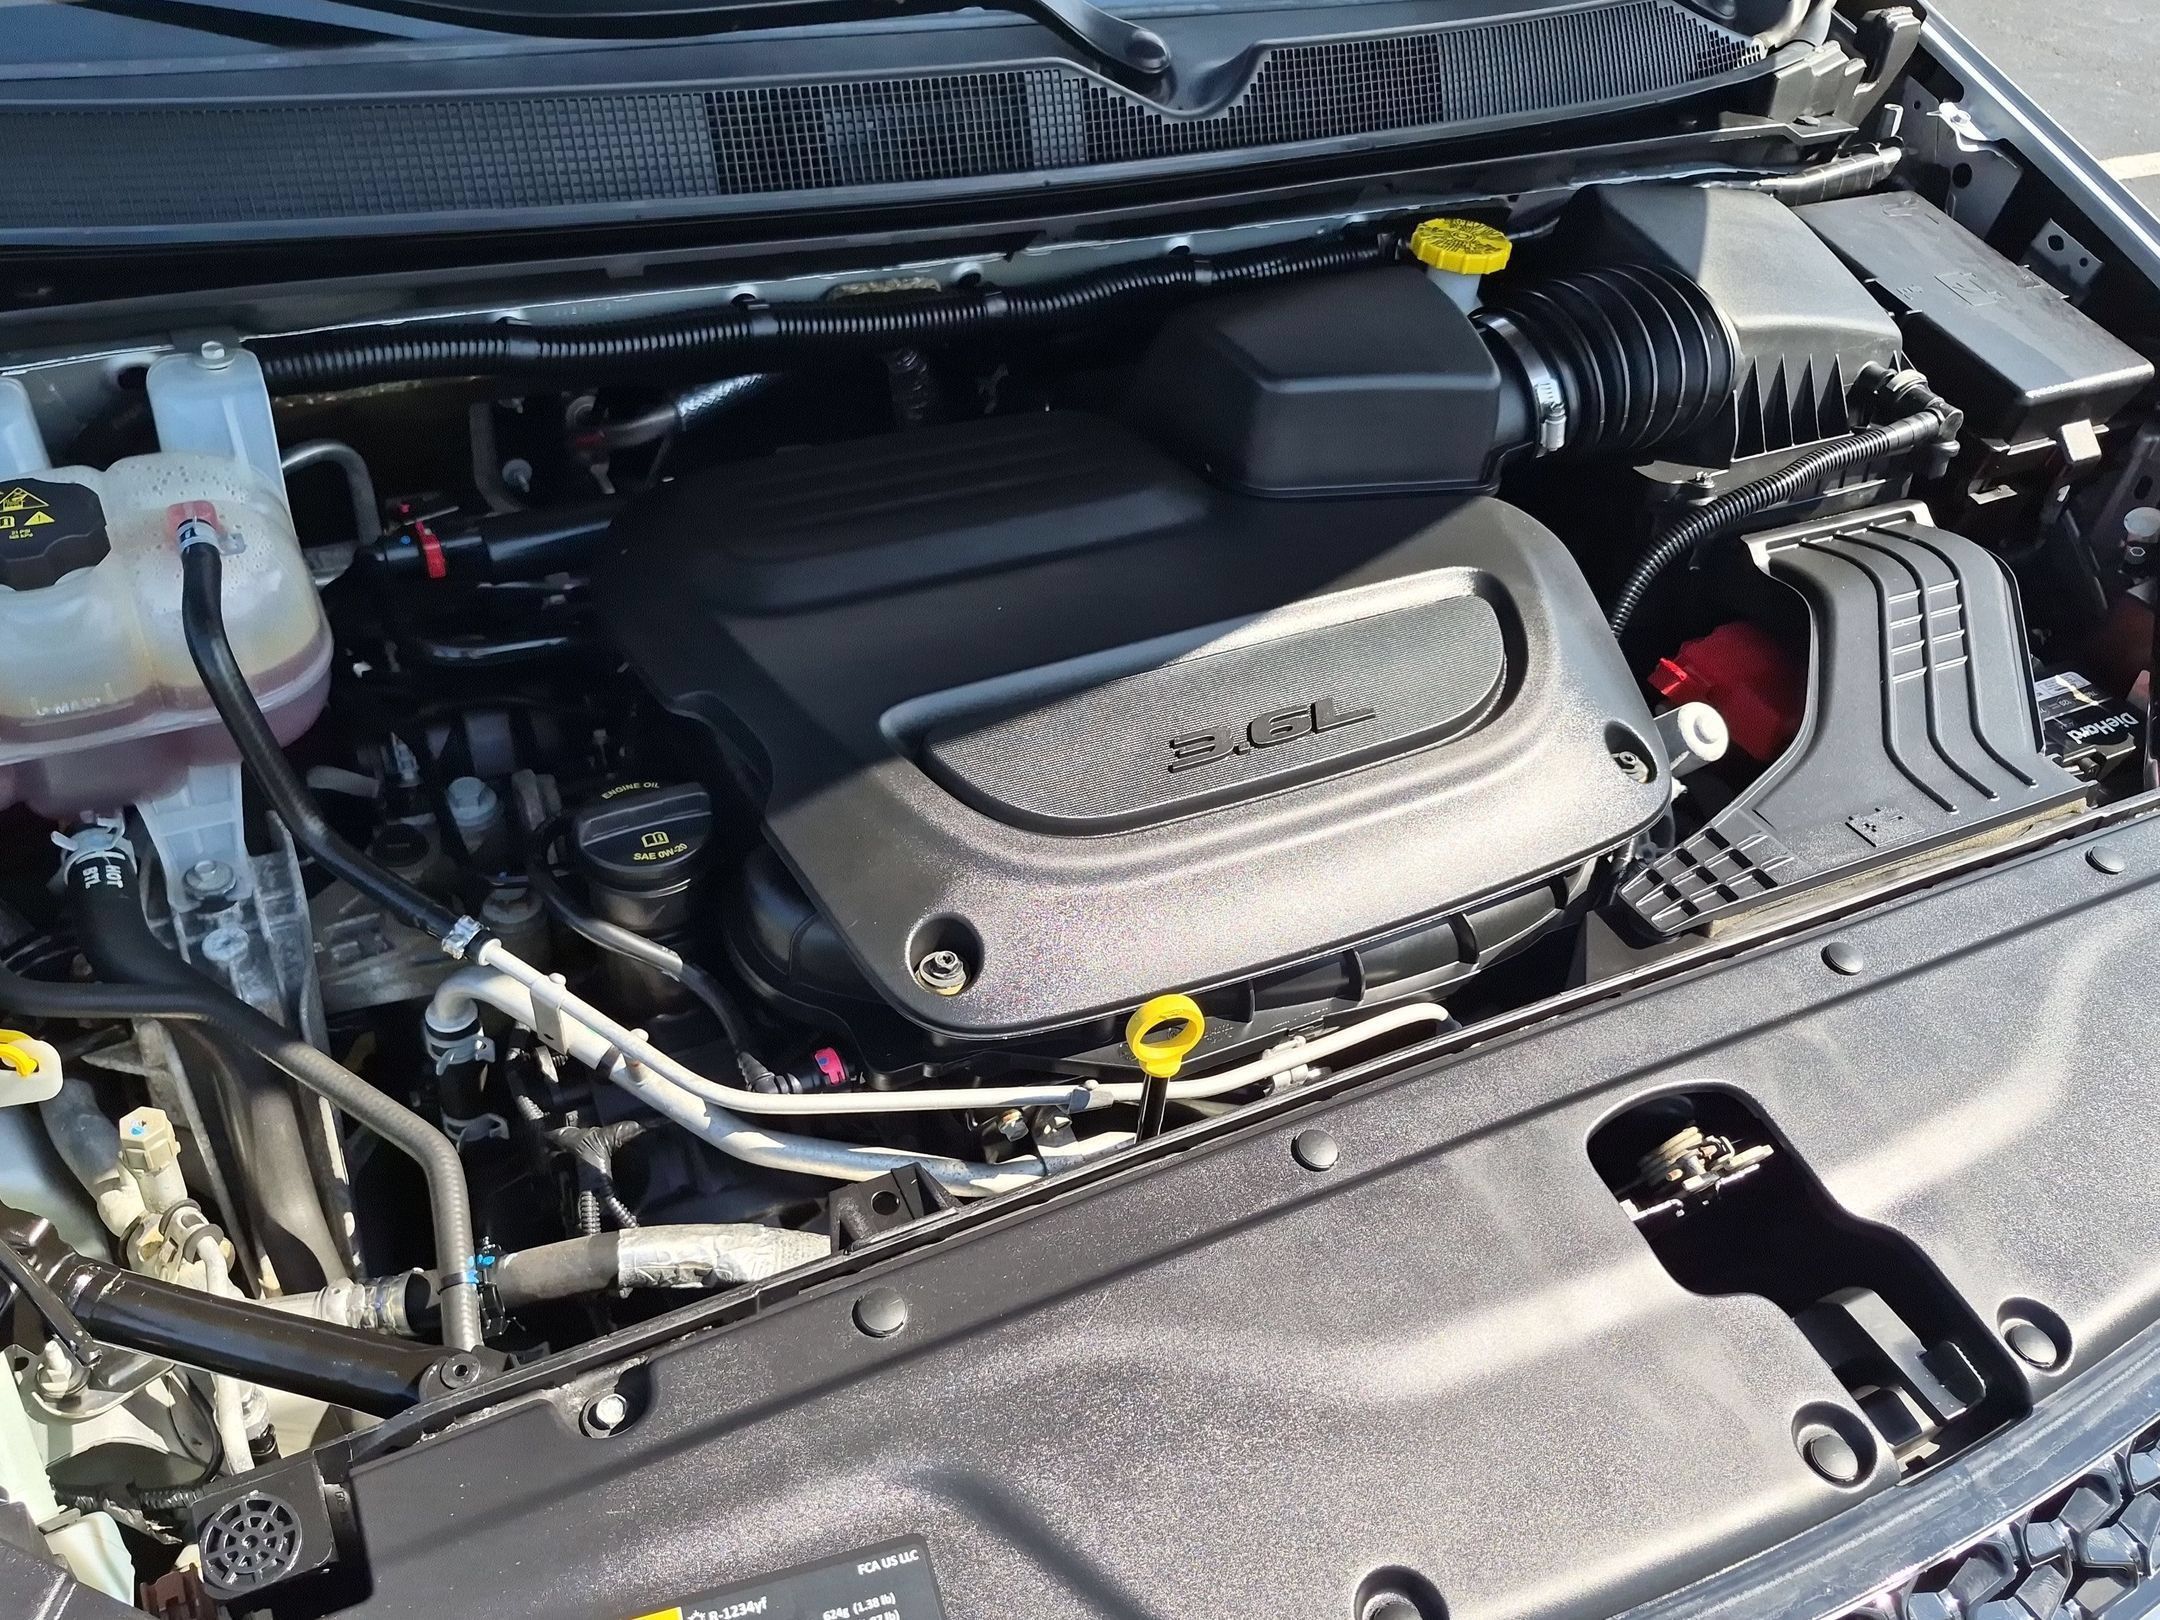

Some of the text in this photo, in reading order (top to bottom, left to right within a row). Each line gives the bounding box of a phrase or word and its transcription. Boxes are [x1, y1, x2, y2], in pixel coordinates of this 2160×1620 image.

[1168, 696, 1376, 773] 3.6L
[2066, 712, 2139, 745] DieHard
[601, 781, 660, 800] ENGINE OIL
[633, 843, 688, 861] SAE 0W-20
[82, 866, 102, 889] BTL
[105, 864, 124, 889] HOT
[857, 1549, 919, 1576] FCA US LLC
[708, 1595, 767, 1620] R-1234yf
[852, 1597, 880, 1615] (1.38
[879, 1591, 896, 1606] lb)
